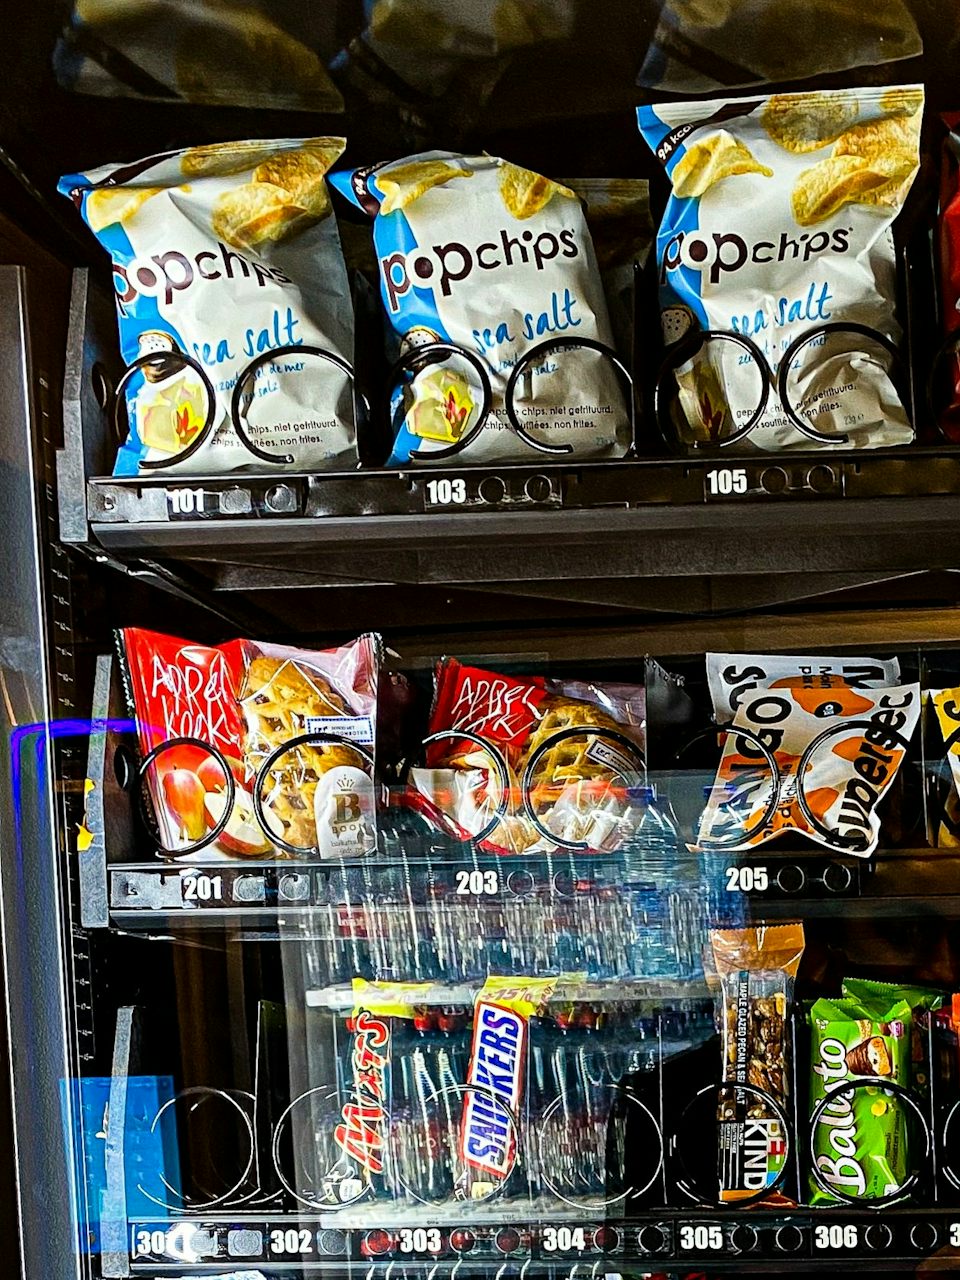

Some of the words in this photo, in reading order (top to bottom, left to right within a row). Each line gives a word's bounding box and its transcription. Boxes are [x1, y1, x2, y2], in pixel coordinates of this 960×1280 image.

[660, 227, 855, 286] popchips
[112, 242, 293, 317] popchips
[382, 229, 578, 312] popchips
[523, 288, 581, 339] salt
[774, 281, 833, 329] salt
[243, 306, 304, 358] salt
[426, 479, 467, 504] 103
[707, 469, 747, 494] 105
[170, 488, 205, 514] 101
[184, 876, 222, 901] 201
[456, 870, 498, 895] 203
[725, 866, 769, 892] 205
[738, 1007, 749, 1037] GLAZED
[738, 1038, 749, 1063] PECAN
[334, 1010, 391, 1174] Mars
[467, 1008, 521, 1168] SNICKERS
[815, 1037, 866, 1196] Balisto
[743, 1118, 771, 1190] KIND
[270, 1229, 312, 1254] 302
[400, 1228, 441, 1252] 303
[543, 1227, 586, 1251] 304
[681, 1225, 723, 1250] 305
[815, 1224, 857, 1249] 306
